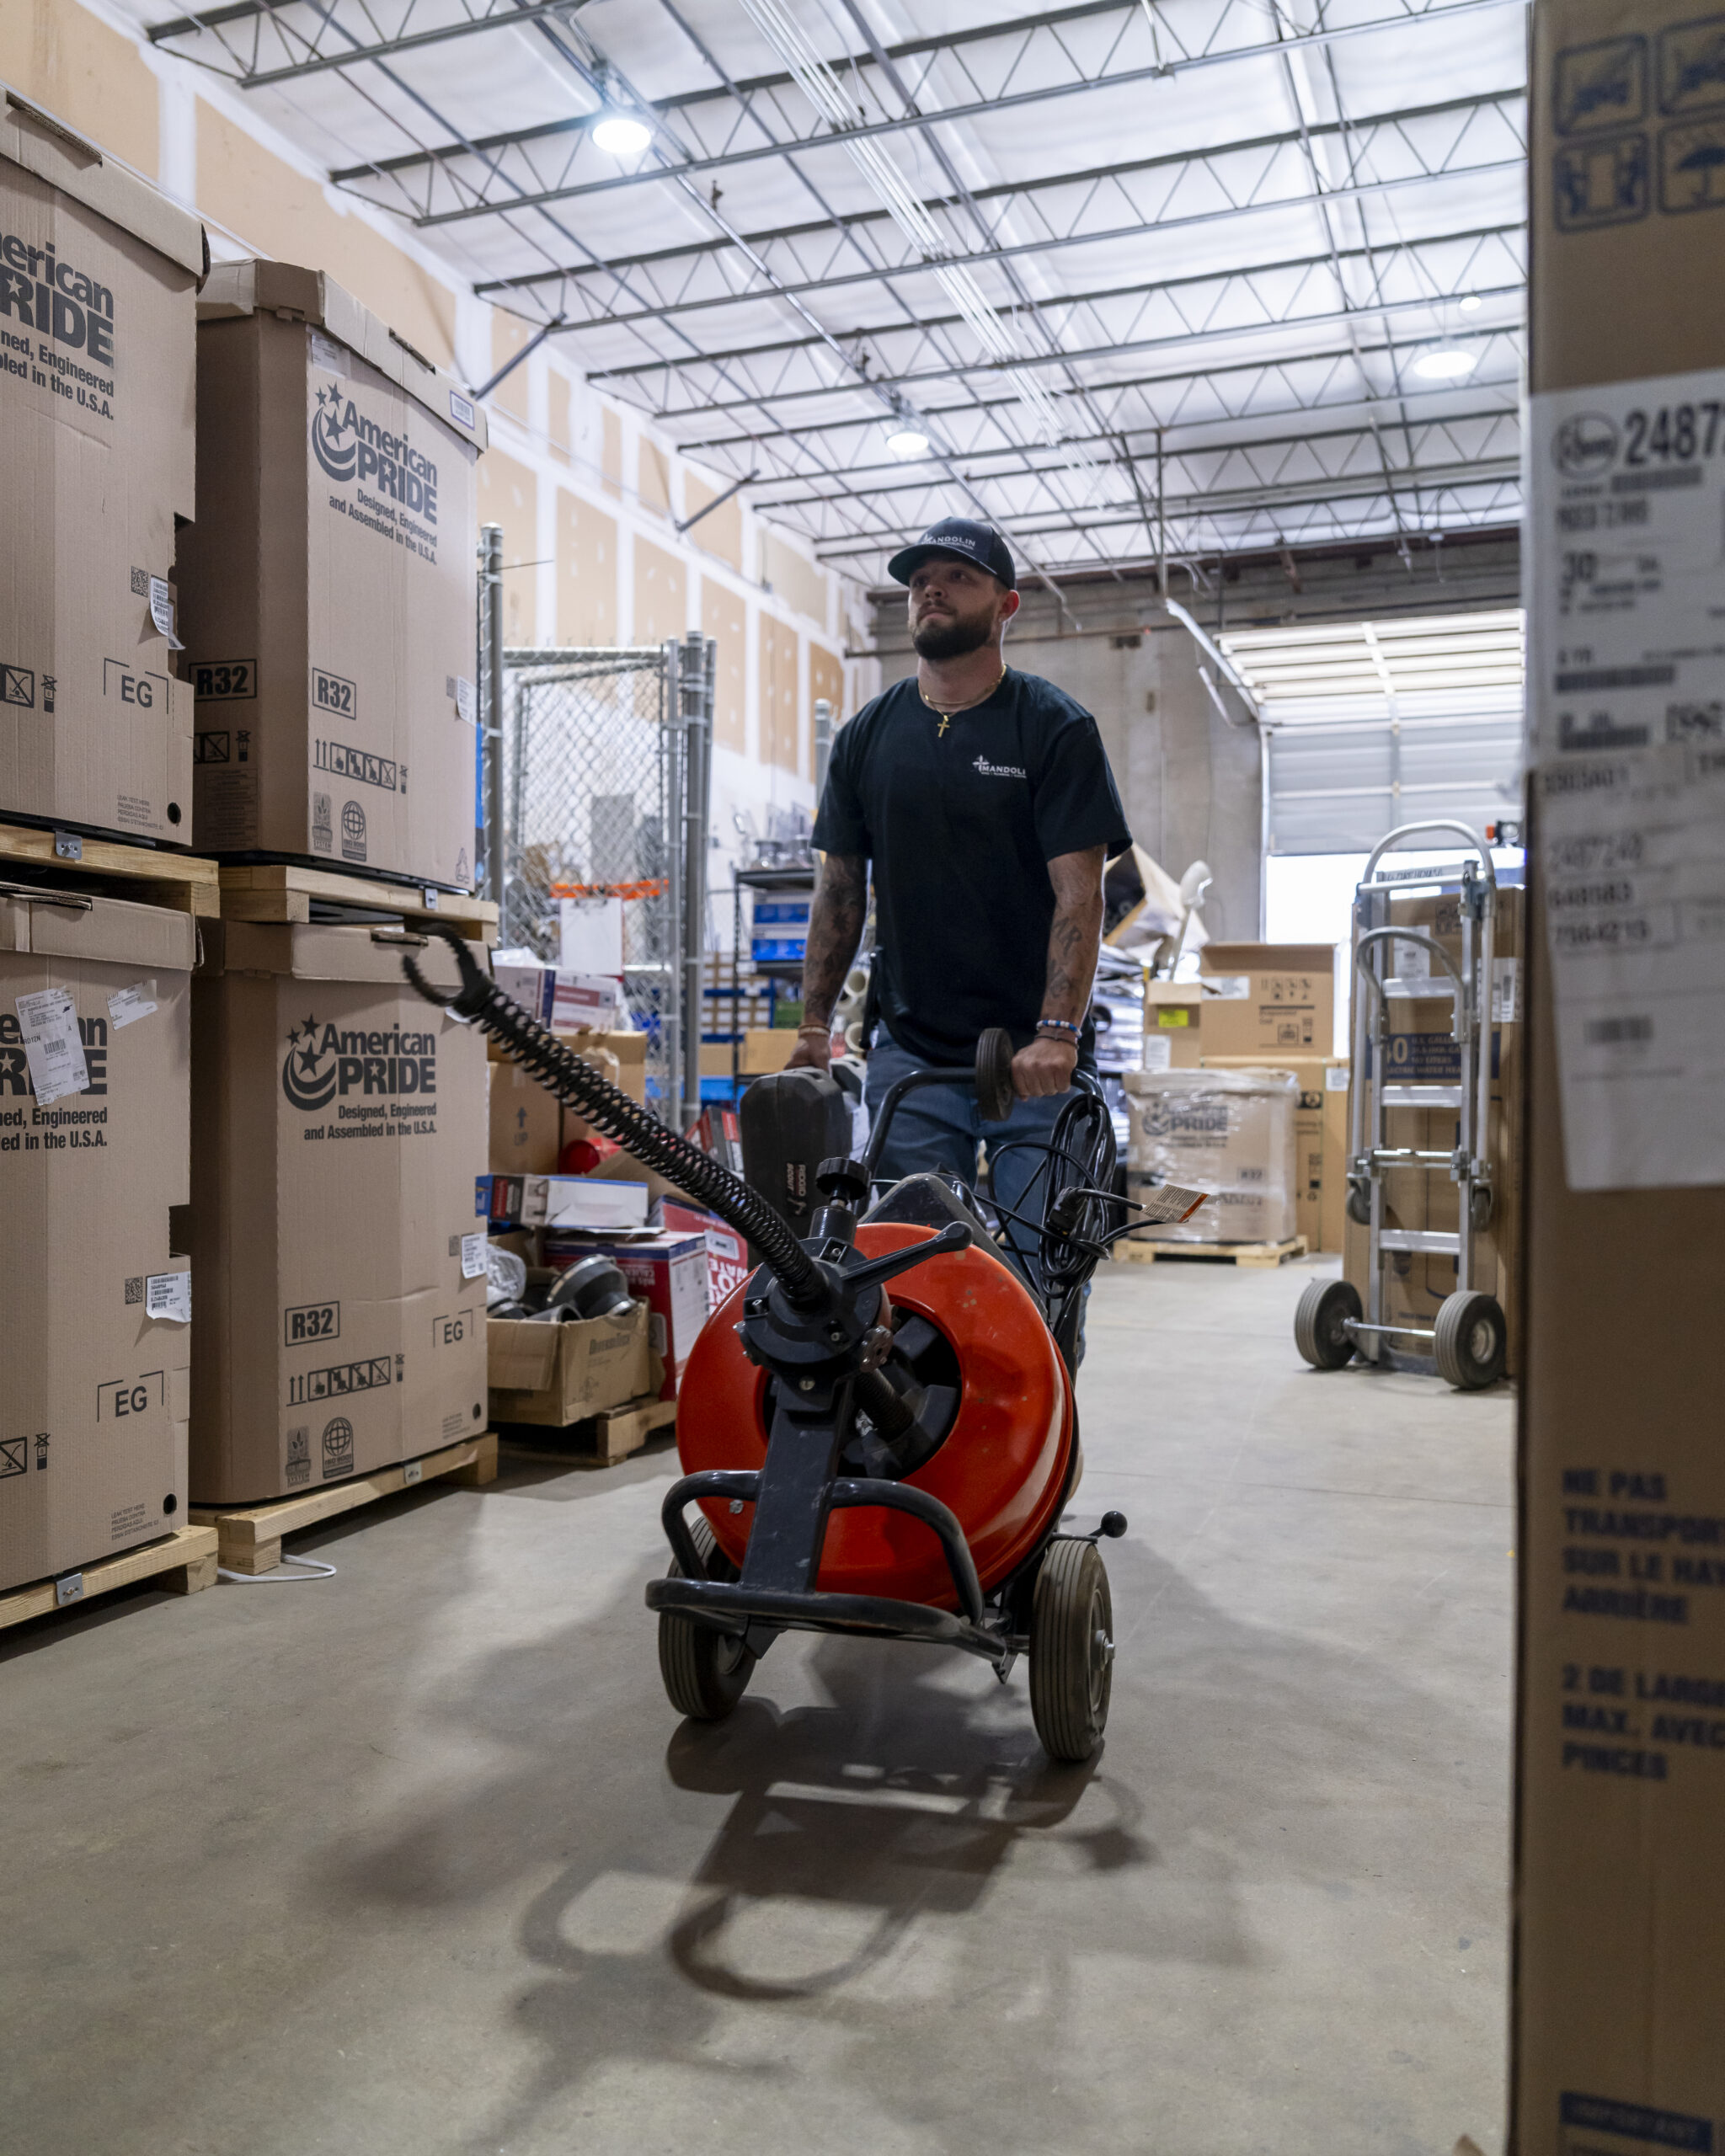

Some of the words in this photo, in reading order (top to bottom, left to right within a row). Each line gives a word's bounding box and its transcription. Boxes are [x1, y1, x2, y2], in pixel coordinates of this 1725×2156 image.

[0, 232, 114, 320] erican
[39, 344, 114, 398] Engineered
[32, 365, 45, 388] in
[51, 374, 72, 400] the
[77, 387, 114, 420] U.S.A.
[342, 400, 437, 488] American
[1625, 398, 1725, 466] 2487
[357, 440, 437, 526] PRIDE
[329, 494, 346, 515] and
[349, 503, 393, 539] Assembled
[396, 528, 403, 544] in
[405, 532, 416, 552] the
[418, 538, 437, 566] U.S.A.
[357, 488, 398, 525] Designed,
[399, 512, 437, 547] Engineered
[121, 674, 152, 708] EG
[197, 665, 248, 696] R32
[318, 675, 351, 712] R32
[319, 1022, 435, 1055] American
[339, 1057, 436, 1095] PRIDE
[32, 1107, 107, 1129] Engineered
[339, 1105, 387, 1121] Designed,
[390, 1102, 436, 1119] Engineered
[1170, 1117, 1227, 1132] PRIDE
[25, 1133, 39, 1150] in
[44, 1132, 66, 1150] the
[70, 1130, 107, 1148] U.S.A.
[304, 1125, 324, 1140] and
[328, 1123, 383, 1139] Assembled
[386, 1122, 395, 1136] in
[398, 1122, 411, 1135] the
[414, 1120, 437, 1134] U.S.A.
[291, 1308, 334, 1341] R32
[443, 1321, 463, 1345] EG
[115, 1385, 147, 1417] EG
[1610, 1470, 1666, 1501] PAS
